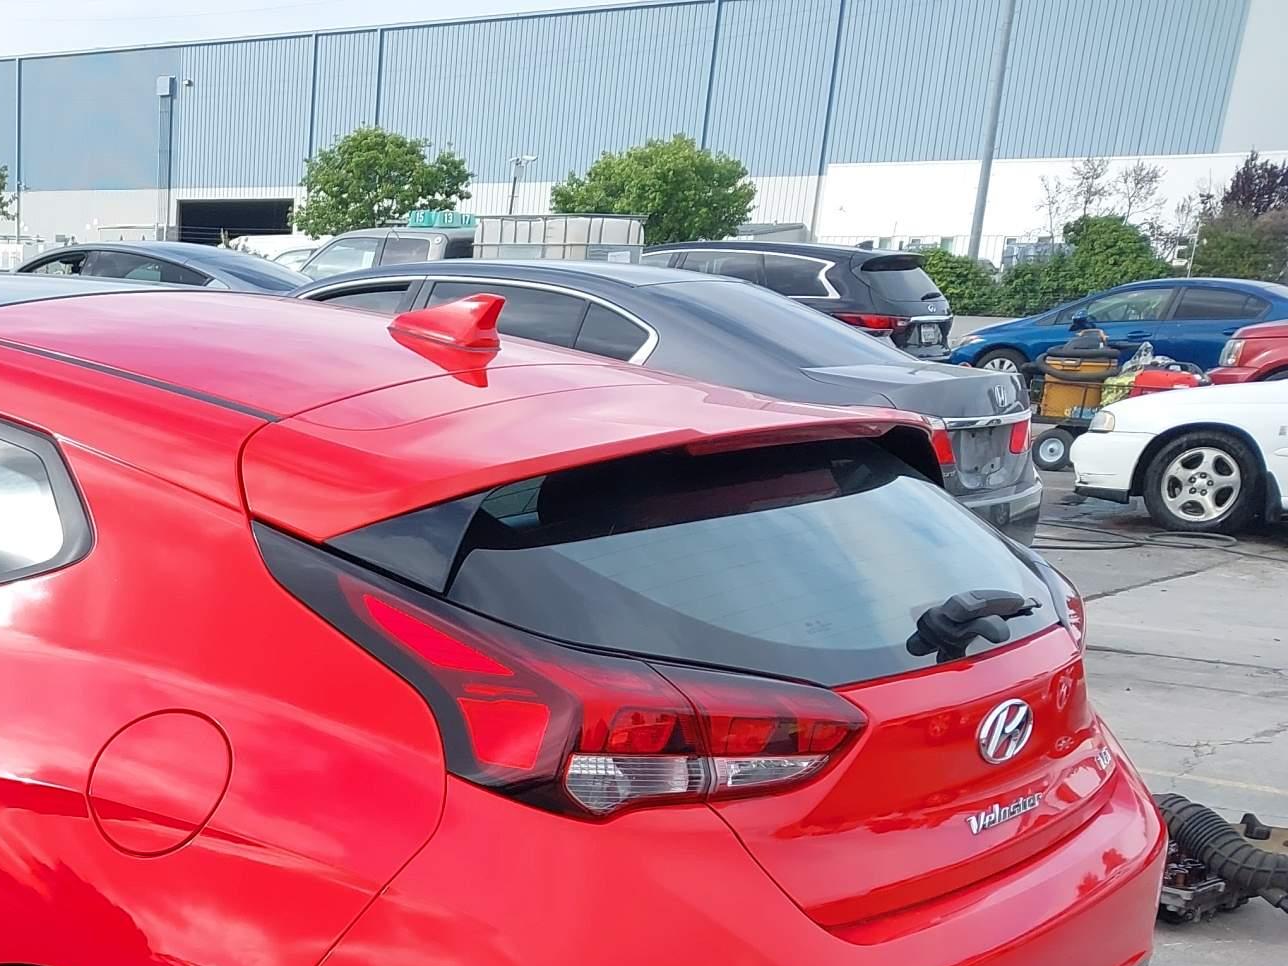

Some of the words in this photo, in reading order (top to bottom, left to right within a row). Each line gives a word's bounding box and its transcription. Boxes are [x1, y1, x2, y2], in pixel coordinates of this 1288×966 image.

[415, 211, 425, 223] 15
[444, 212, 454, 224] 13
[462, 214, 471, 225] 17
[966, 792, 1043, 834] Veloster
